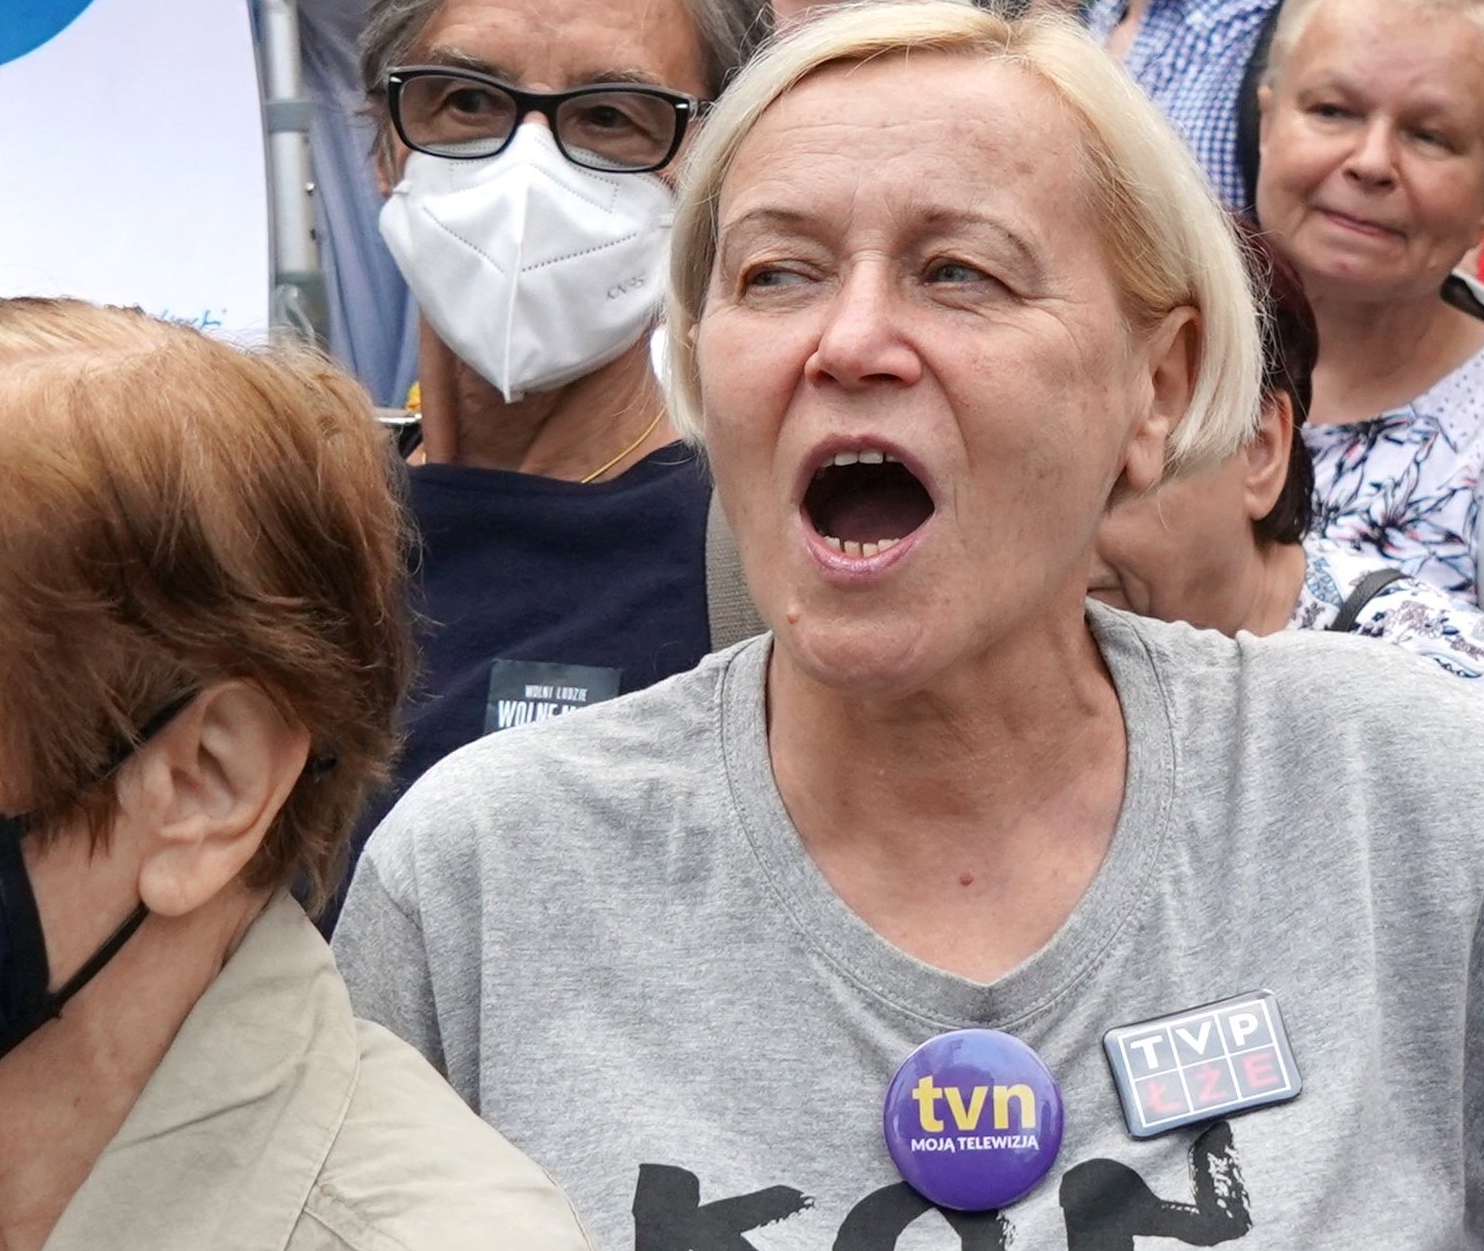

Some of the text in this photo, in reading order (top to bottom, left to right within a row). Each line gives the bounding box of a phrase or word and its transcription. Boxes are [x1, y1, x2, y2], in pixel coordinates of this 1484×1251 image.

[1130, 1012, 1259, 1069] TVP
[911, 1075, 1036, 1133] tvn
[911, 1134, 1040, 1153] MOJĄ TELEWIZJĄ
